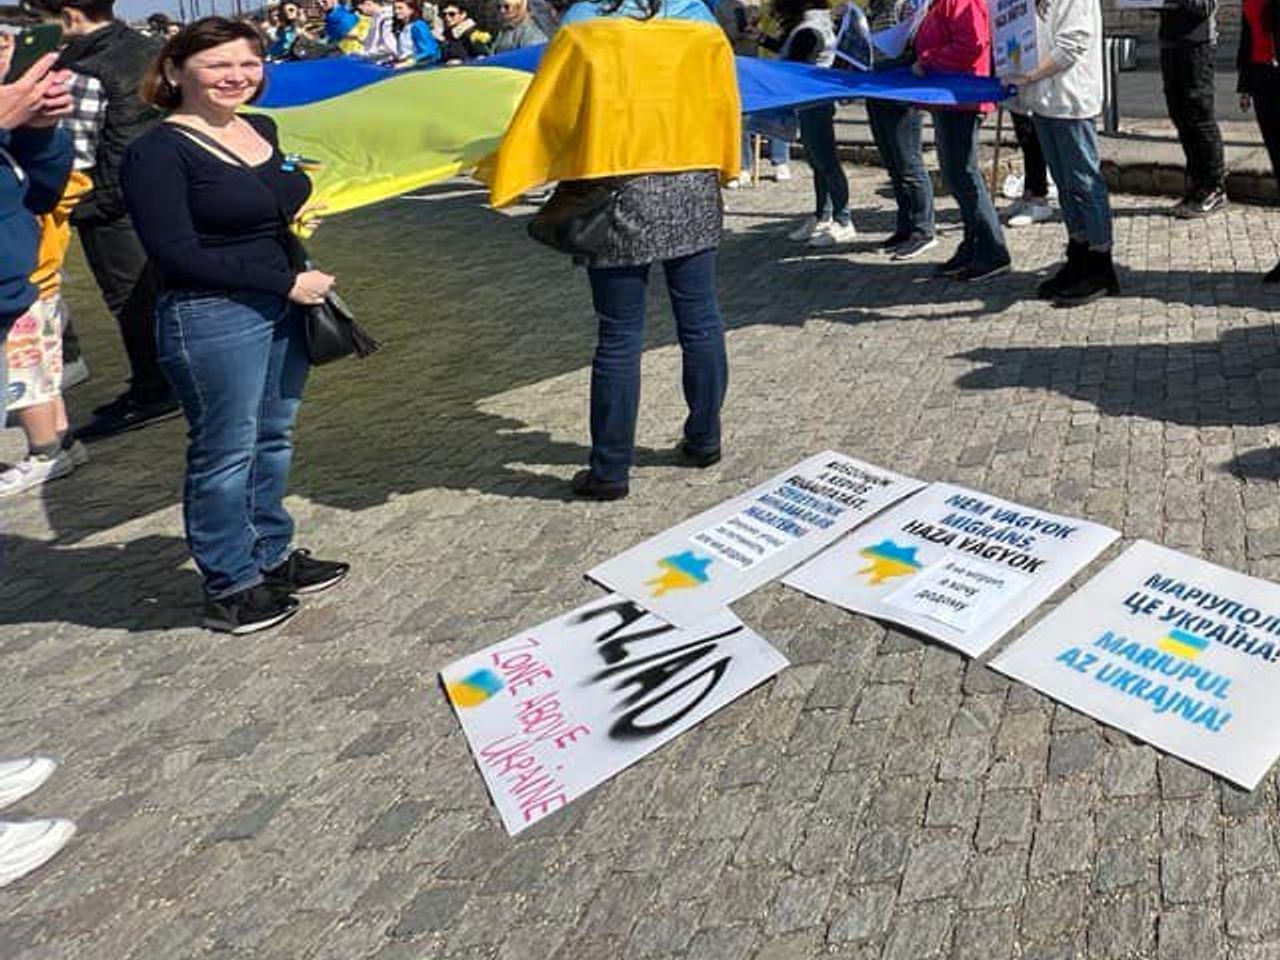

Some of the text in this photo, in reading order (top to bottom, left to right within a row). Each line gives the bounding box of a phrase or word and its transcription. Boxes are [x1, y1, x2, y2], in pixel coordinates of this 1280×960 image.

[944, 493, 1079, 540] NEM VAGYOK
[901, 519, 1045, 574] HAZA VAGYOK
[1122, 591, 1160, 616] ЦЕ
[491, 637, 554, 697] ZONE
[1056, 646, 1233, 733] AZ UKRAJNA!
[1094, 629, 1233, 700] MARIUPUL
